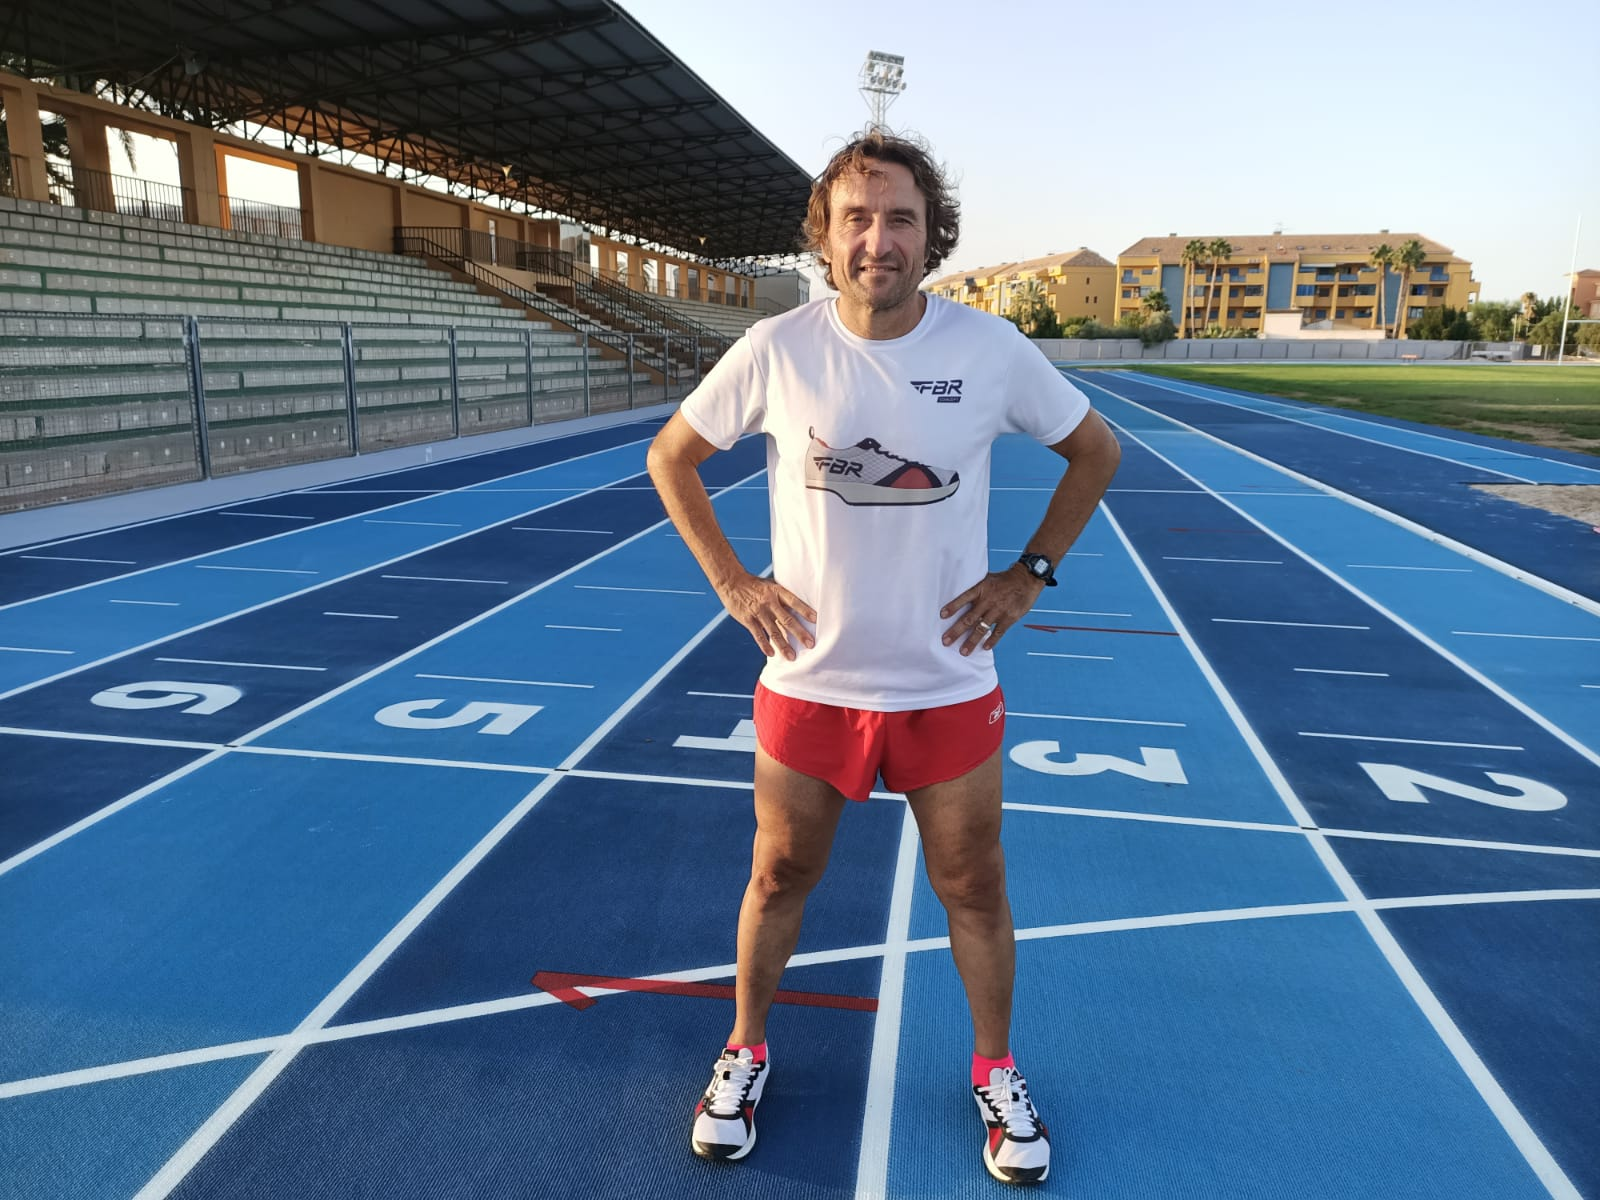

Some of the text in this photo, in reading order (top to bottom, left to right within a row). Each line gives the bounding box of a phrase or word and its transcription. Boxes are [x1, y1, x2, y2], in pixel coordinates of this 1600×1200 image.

[910, 379, 963, 395] FBR
[813, 456, 864, 478] FBR
[90, 680, 244, 715] 6
[374, 698, 544, 736] 5
[1009, 740, 1189, 785] 3
[1359, 762, 1568, 812] 2
